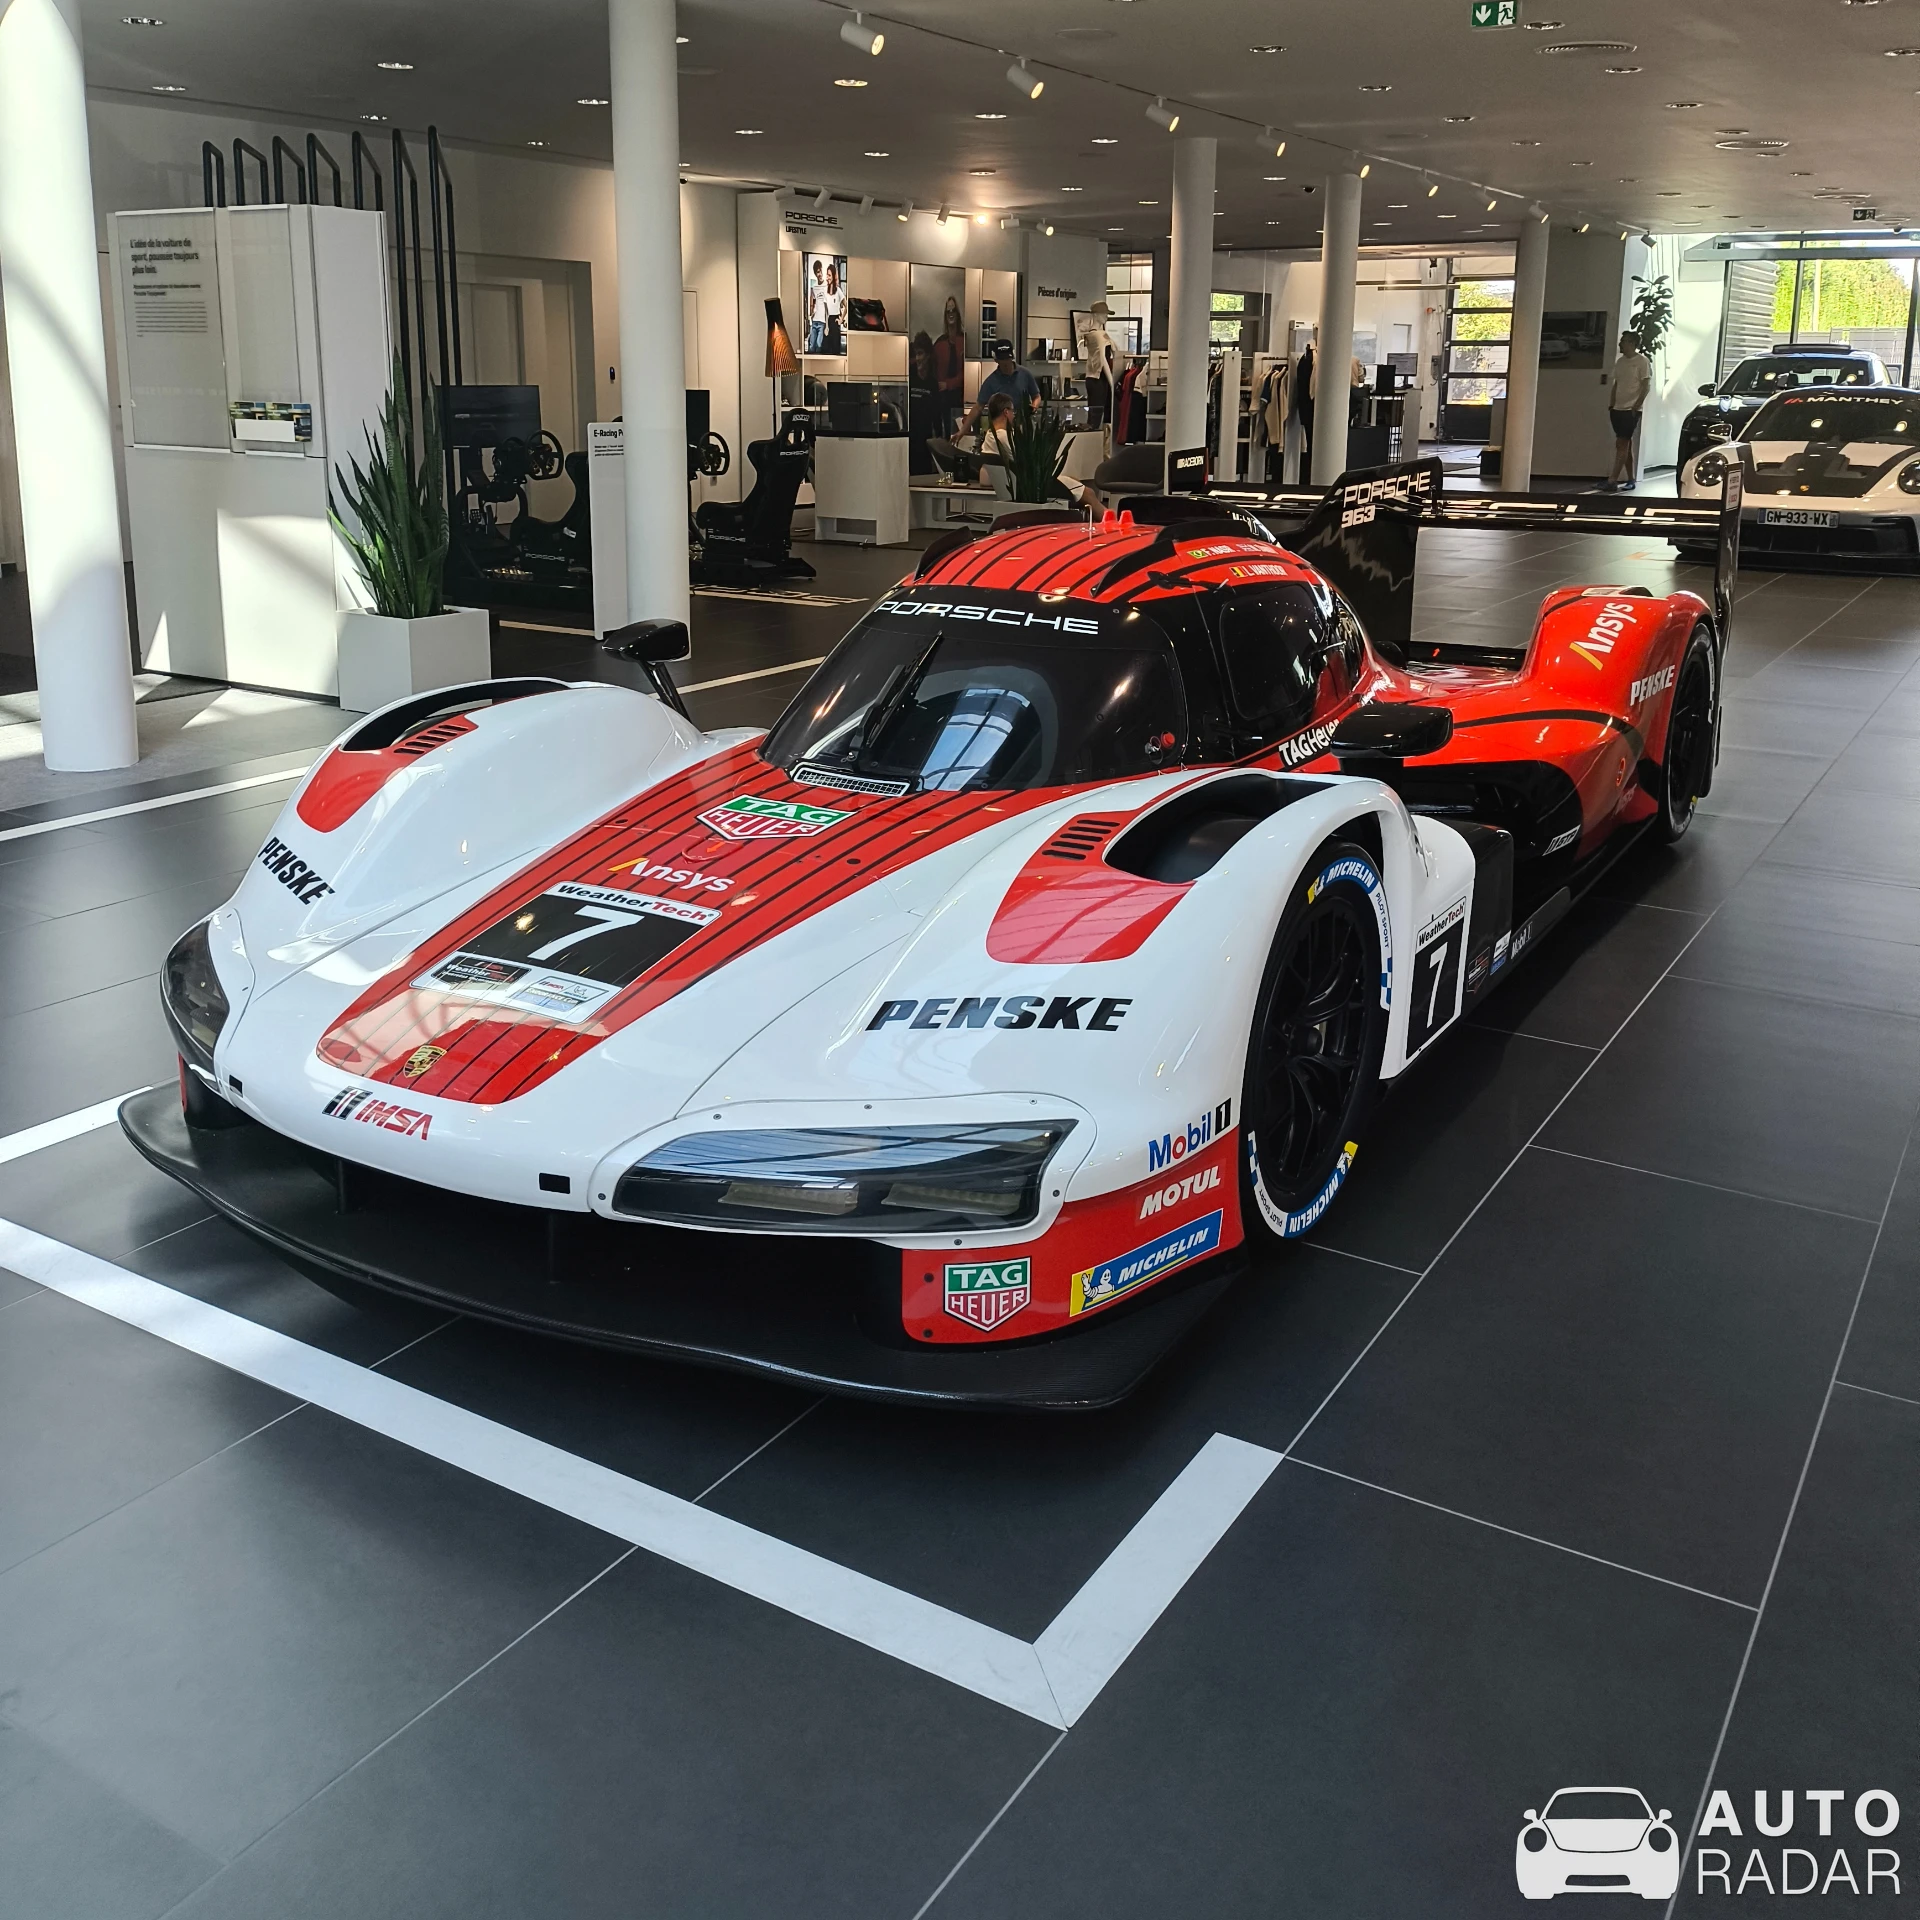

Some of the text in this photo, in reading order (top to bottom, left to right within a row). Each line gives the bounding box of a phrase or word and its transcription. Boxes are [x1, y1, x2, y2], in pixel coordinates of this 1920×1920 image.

[785, 211, 838, 225] PORSCHE
[785, 226, 807, 235] LIFESTYLE
[1806, 396, 1904, 405] MANTHEY
[593, 429, 618, 439] E-Racing
[1343, 471, 1431, 508] PORSCHE
[1341, 505, 1375, 529] 963
[709, 534, 746, 542] PORSCHE
[525, 552, 566, 562] PORSCHE
[874, 601, 1099, 635] PORSCHE
[1569, 602, 1637, 671] Ansys
[1630, 665, 1675, 707] PENSKE
[709, 810, 819, 836] HEUER
[744, 799, 839, 823] TAG
[257, 836, 336, 906] PENSKE
[607, 857, 735, 891] Ansys
[1326, 861, 1376, 889] MICHELIN
[557, 884, 708, 922] WeatherTech
[1375, 892, 1390, 948] PILOT SPORT
[527, 904, 645, 961] 7
[1418, 902, 1464, 947] WeatherTech
[1427, 942, 1448, 1029] 7
[865, 996, 1133, 1031] PENSKE
[354, 1099, 433, 1141] IMSA
[1148, 1111, 1211, 1172] Mobil
[1139, 1165, 1221, 1220] MOTUL
[1258, 1188, 1283, 1227] PILOT SPORT
[1289, 1173, 1339, 1233] MICHELIN
[1118, 1228, 1209, 1285] MICHELIN
[953, 1265, 1022, 1289] TAG
[951, 1290, 1024, 1325] HEUER
